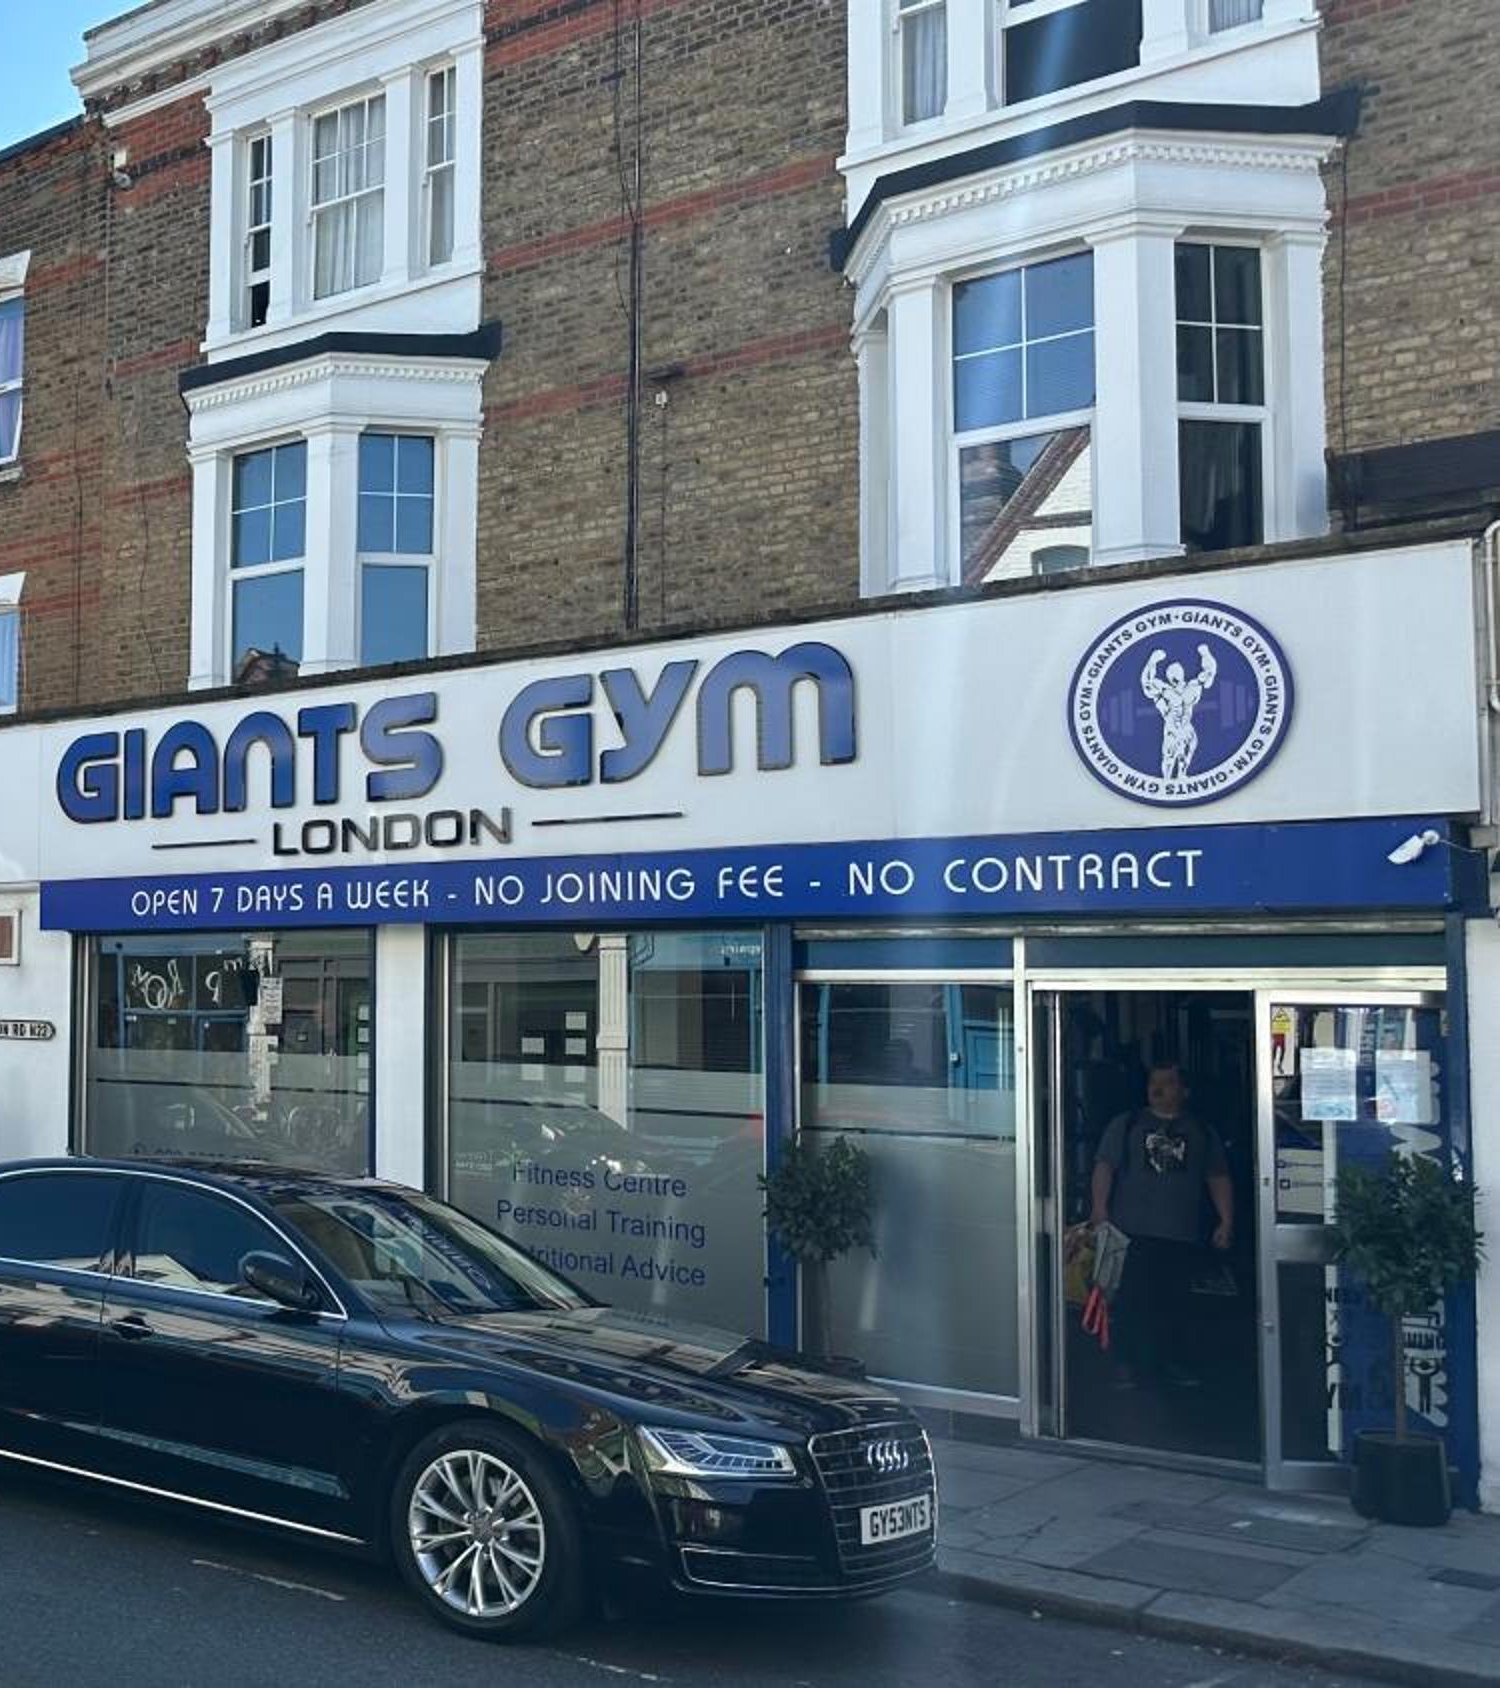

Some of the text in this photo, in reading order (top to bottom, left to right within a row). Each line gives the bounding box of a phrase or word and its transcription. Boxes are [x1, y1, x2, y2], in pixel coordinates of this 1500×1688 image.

[1089, 613, 1172, 677] GIANTS GYM
[1182, 611, 1271, 668] GIANTS GYM
[1079, 686, 1119, 775] GIANTS GYM
[1233, 675, 1279, 771] GIANTS GYM
[56, 691, 444, 824] GIANTS
[1123, 771, 1228, 795] GIANTS GYM
[272, 807, 514, 857] LONDON
[131, 889, 198, 916] OPEN
[211, 887, 226, 914] 7
[237, 884, 303, 913] DAYS
[317, 883, 333, 910] A
[347, 879, 430, 909] WEEK
[475, 875, 524, 905] NO
[541, 868, 695, 905] JOINING
[718, 865, 784, 900] FEE
[848, 861, 915, 896] NO
[943, 850, 1203, 893] CONTRACT
[13, 1023, 26, 1036] RD
[30, 1023, 47, 1036] N22
[513, 1162, 595, 1189] Fitness
[604, 1167, 687, 1197] Centre
[497, 1200, 706, 1249] Personal Training
[527, 1246, 706, 1286] tritional Advice
